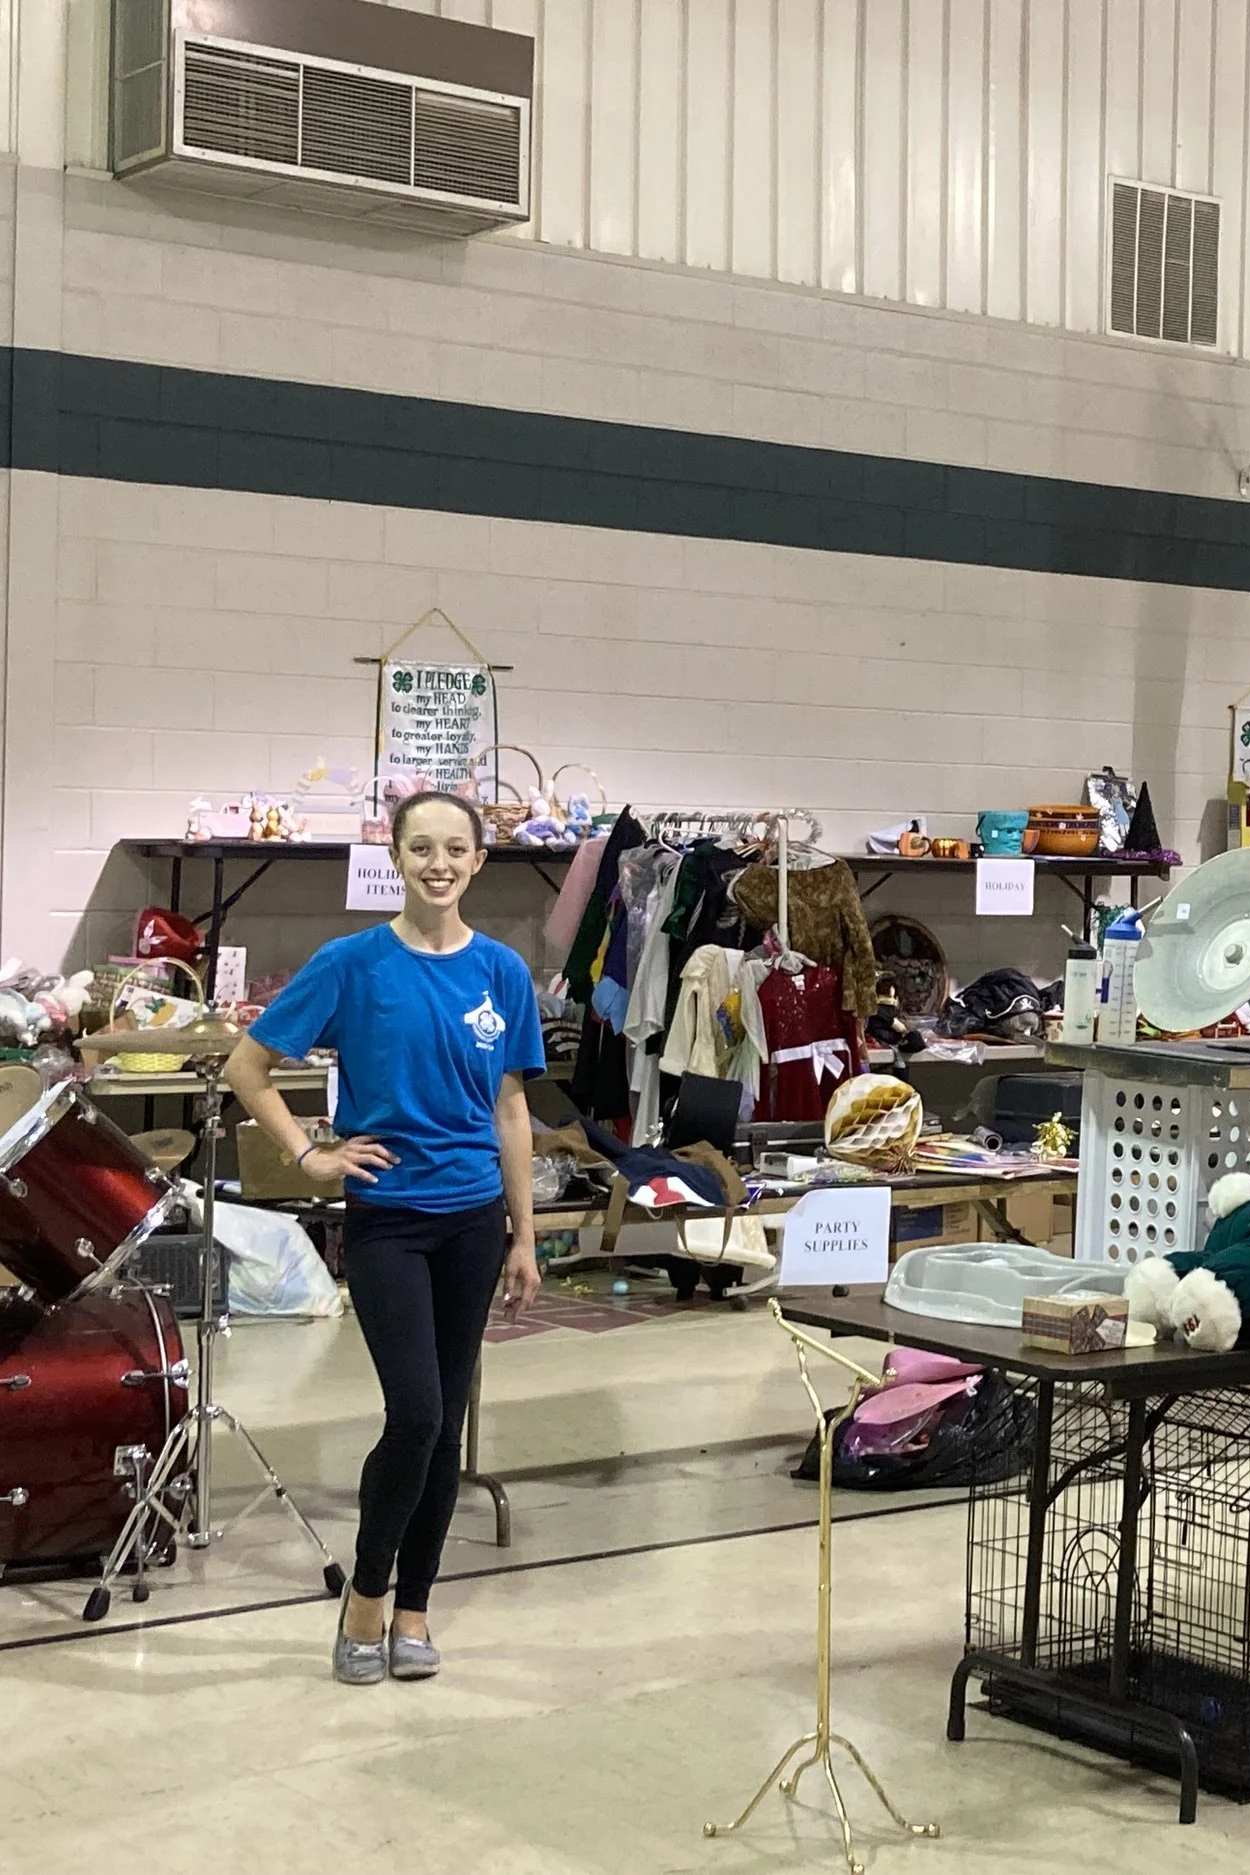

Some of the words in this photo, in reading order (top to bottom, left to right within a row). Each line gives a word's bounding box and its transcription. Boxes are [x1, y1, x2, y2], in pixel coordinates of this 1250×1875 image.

[416, 670, 423, 690] I
[425, 670, 471, 691] PLEDGE
[416, 694, 431, 706] my
[433, 692, 466, 705] HEAD
[391, 702, 402, 713] to
[403, 703, 438, 716] clearer
[416, 720, 431, 732] my
[435, 718, 471, 730] HEART
[392, 728, 402, 738] to
[416, 745, 431, 757] my
[390, 753, 400, 764] to
[358, 868, 402, 880] HOLID
[984, 881, 1026, 891] HOLIDAY
[815, 1220, 860, 1235] PARTY
[803, 1239, 869, 1253] SUPPLIES
